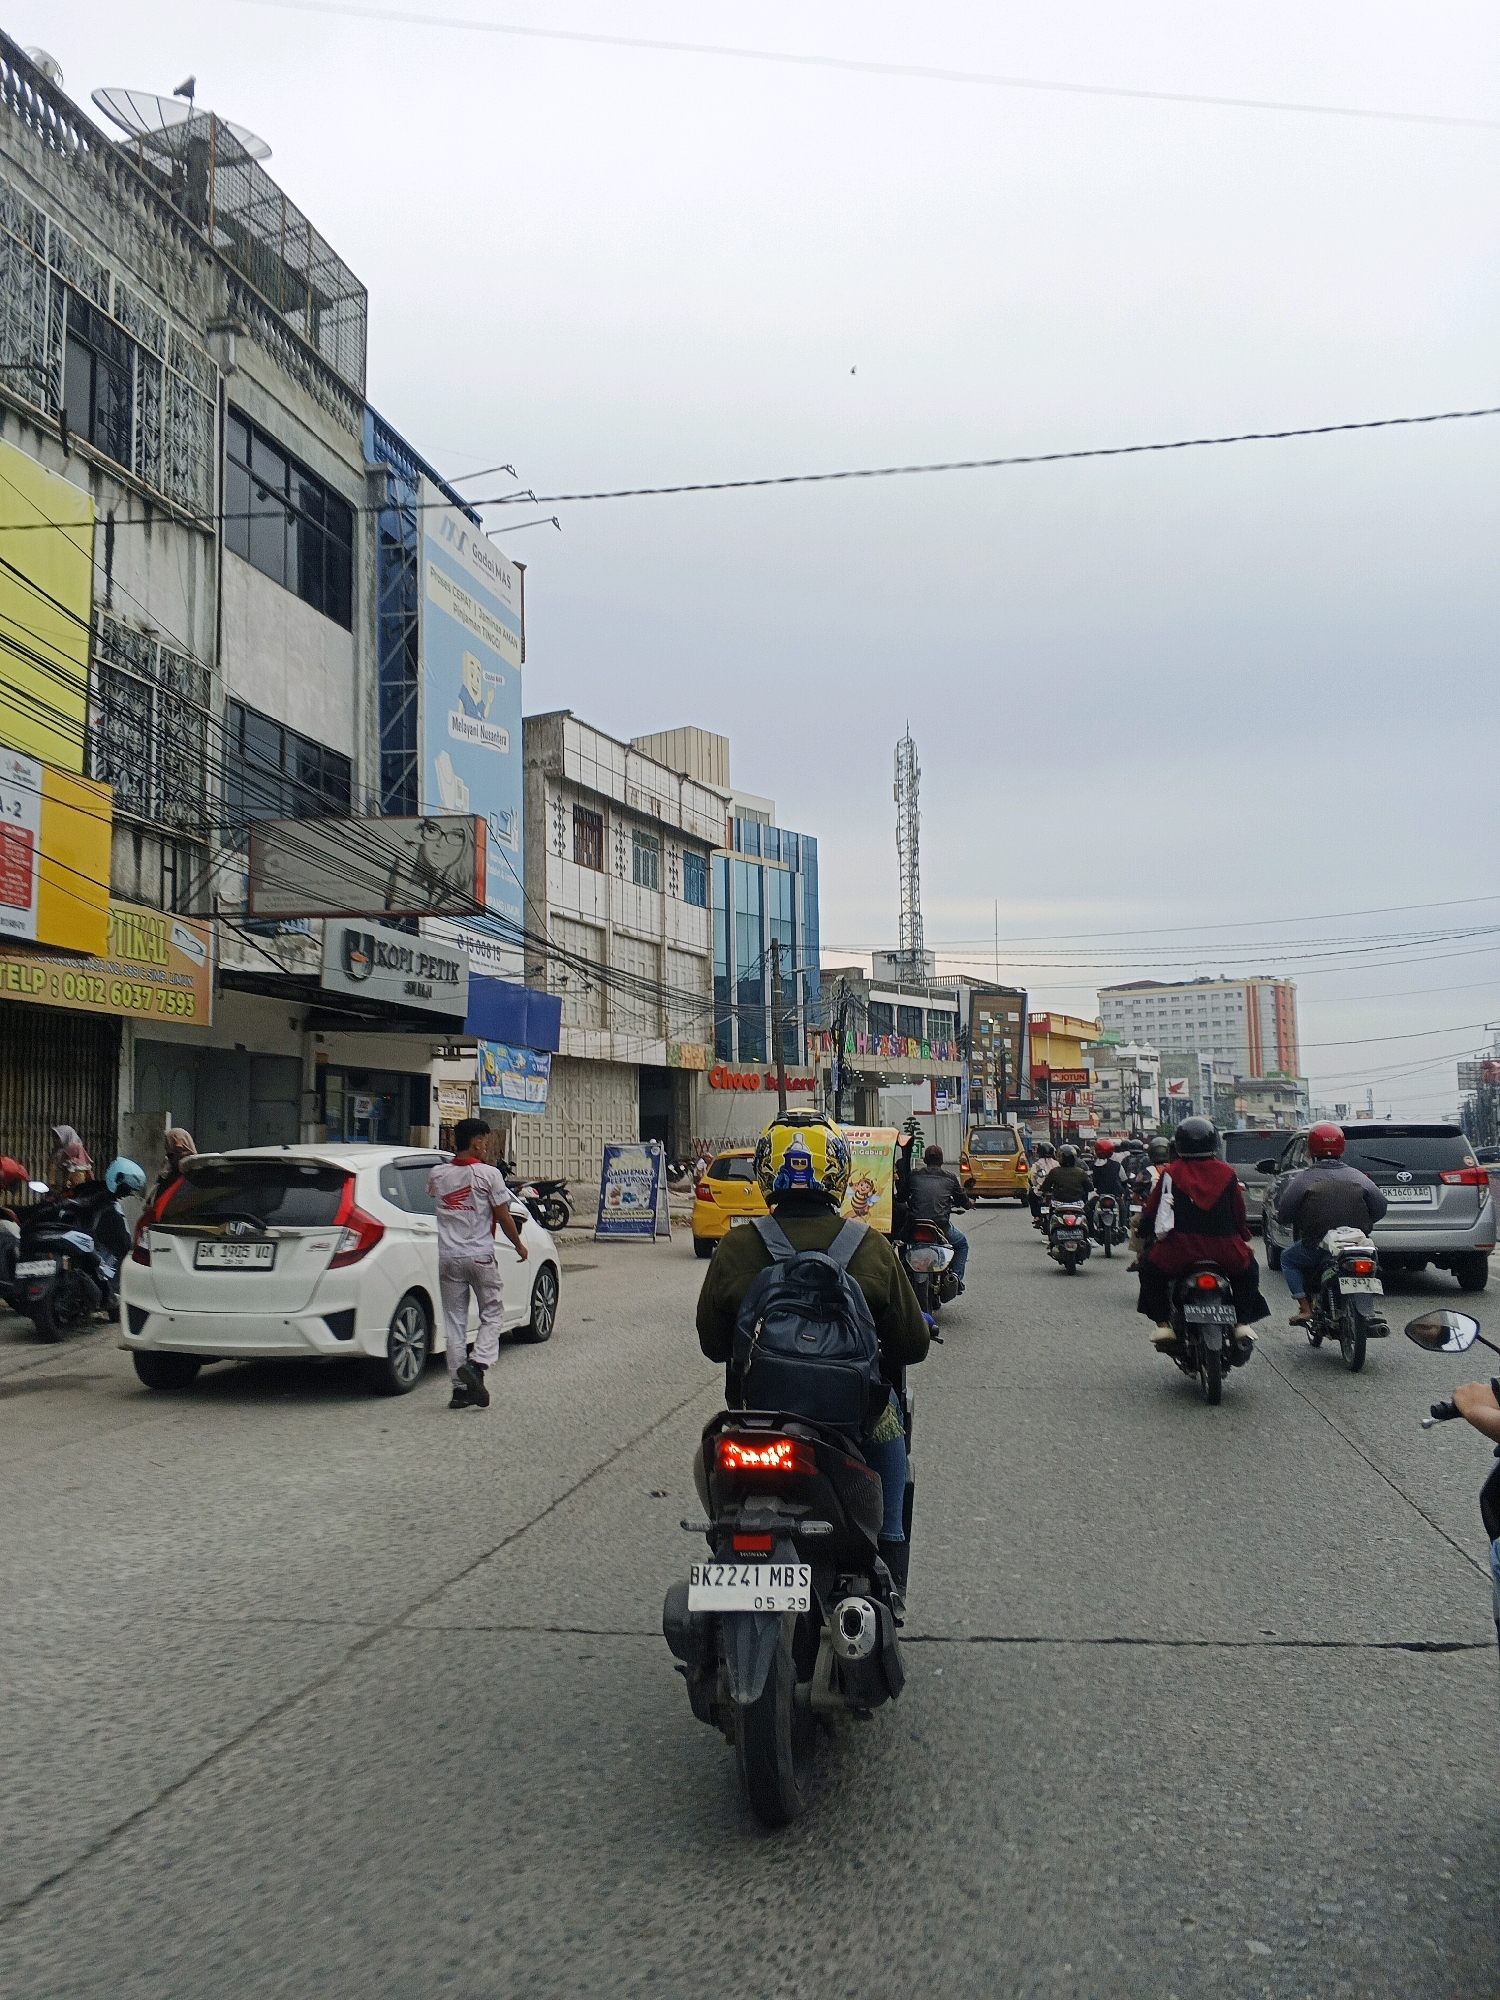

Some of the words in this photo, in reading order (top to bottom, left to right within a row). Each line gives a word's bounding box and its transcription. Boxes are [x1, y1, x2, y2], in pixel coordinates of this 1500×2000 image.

[452, 716, 479, 739] Melayani
[374, 939, 414, 974] KOPI
[416, 952, 460, 986] PETIK
[63, 972, 106, 1004] 0812
[110, 980, 153, 1011] 6037
[156, 988, 196, 1017] 7593
[872, 1033, 917, 1059] PASAR
[709, 1065, 760, 1091] Choco
[769, 1566, 809, 1587] MBS
